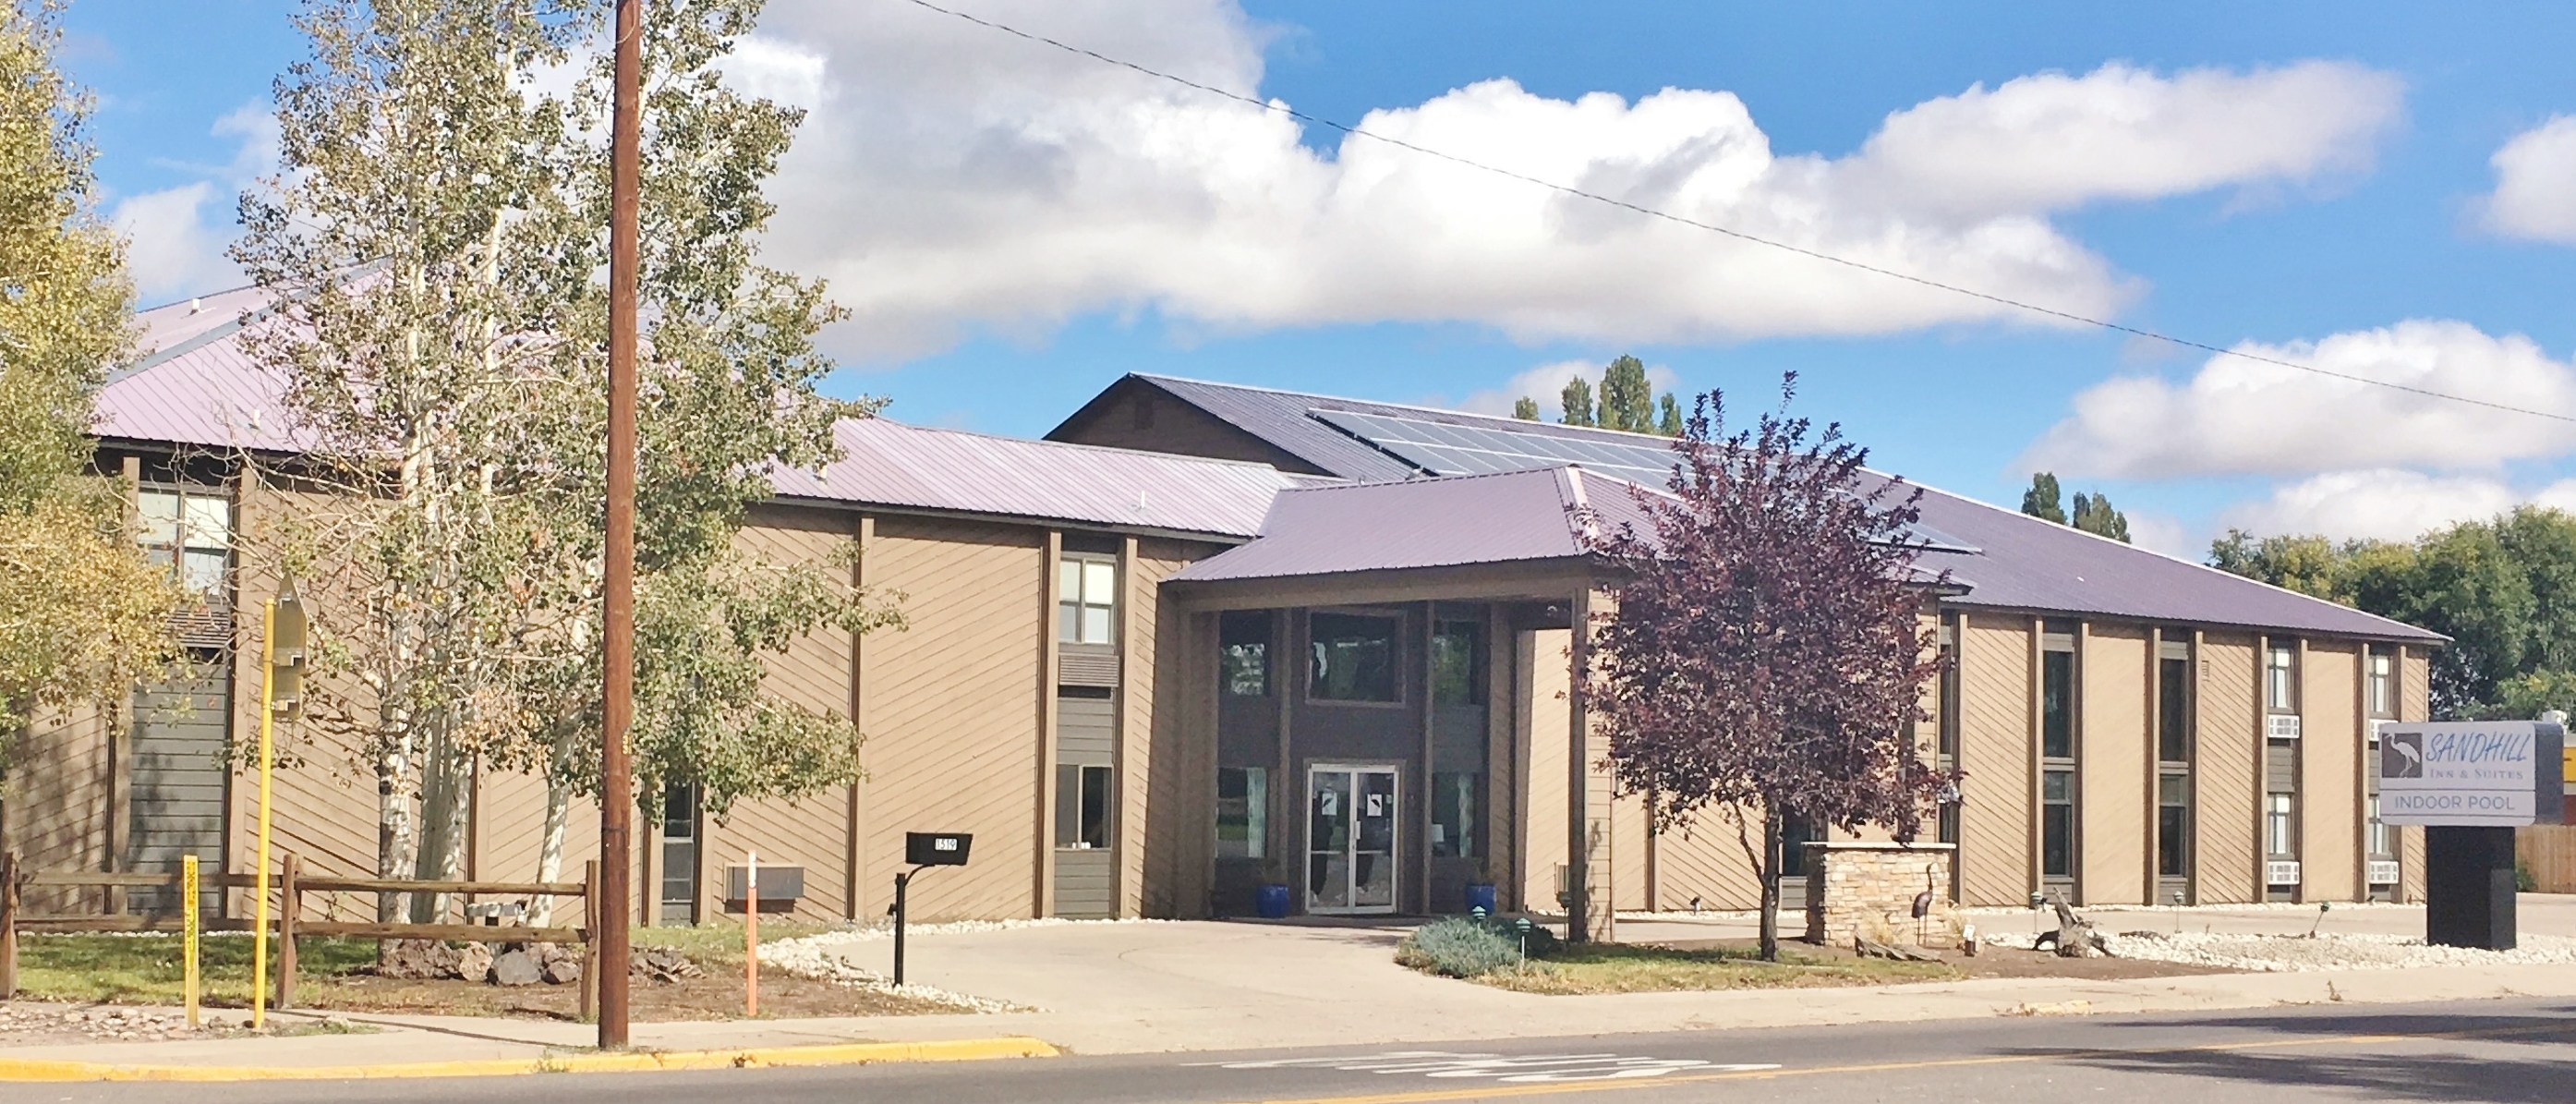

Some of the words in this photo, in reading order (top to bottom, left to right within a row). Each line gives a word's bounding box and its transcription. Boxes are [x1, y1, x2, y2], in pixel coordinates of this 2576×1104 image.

[2425, 731, 2531, 763] SANDHILL
[2460, 769, 2469, 779] &
[2395, 795, 2462, 809] INDOOR
[2468, 795, 2515, 810] POOL
[937, 839, 956, 850] 1519
